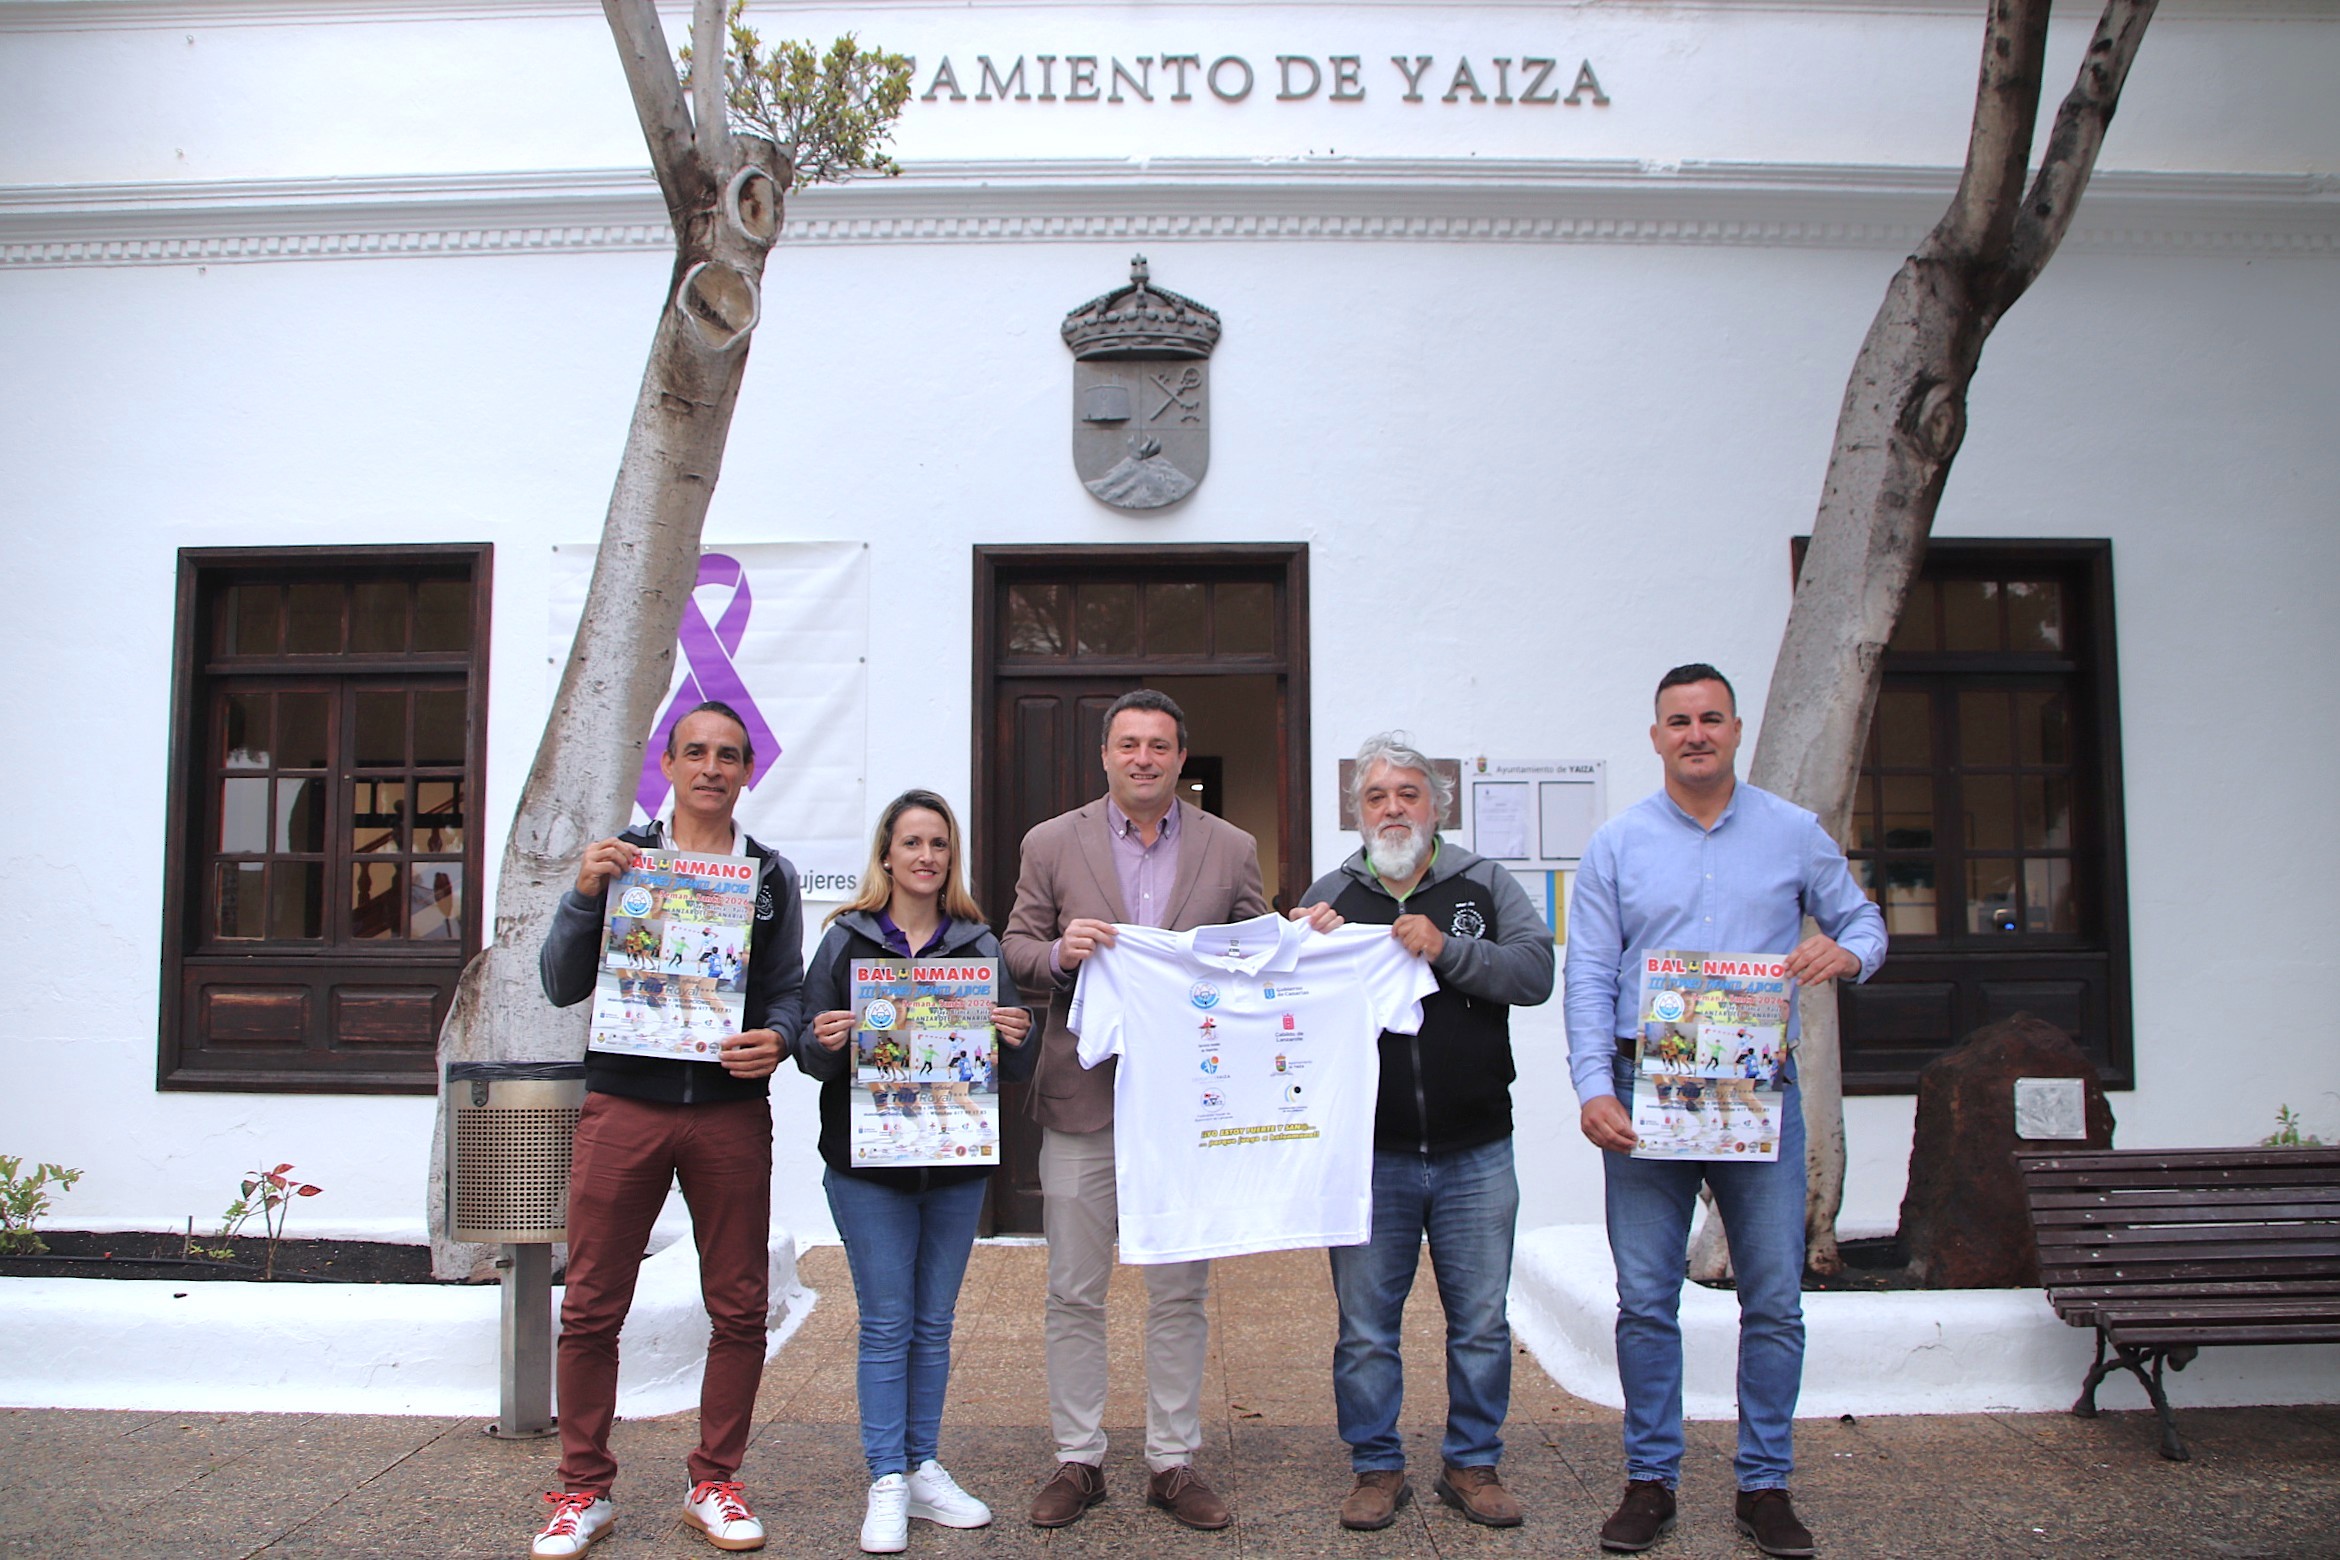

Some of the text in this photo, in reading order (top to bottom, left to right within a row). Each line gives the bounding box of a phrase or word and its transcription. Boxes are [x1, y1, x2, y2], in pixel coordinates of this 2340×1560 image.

[1276, 54, 1366, 101] DE
[1390, 56, 1611, 106] YAIZA
[1496, 765, 1594, 774] Ayuntamiento de YAIZA
[798, 869, 857, 894] ujeres
[659, 890, 692, 900] Semana
[668, 907, 707, 917] LANZAROTE
[666, 983, 699, 997] Royal
[859, 985, 875, 999] III
[902, 1000, 936, 1008] Semana
[920, 1091, 952, 1103] Royal
[1220, 1127, 1246, 1137] ESTOY
[1246, 1124, 1276, 1134] FUERTE
[1277, 1123, 1284, 1132] Y
[1208, 1137, 1237, 1148] porque
[1238, 1135, 1261, 1145] juego
